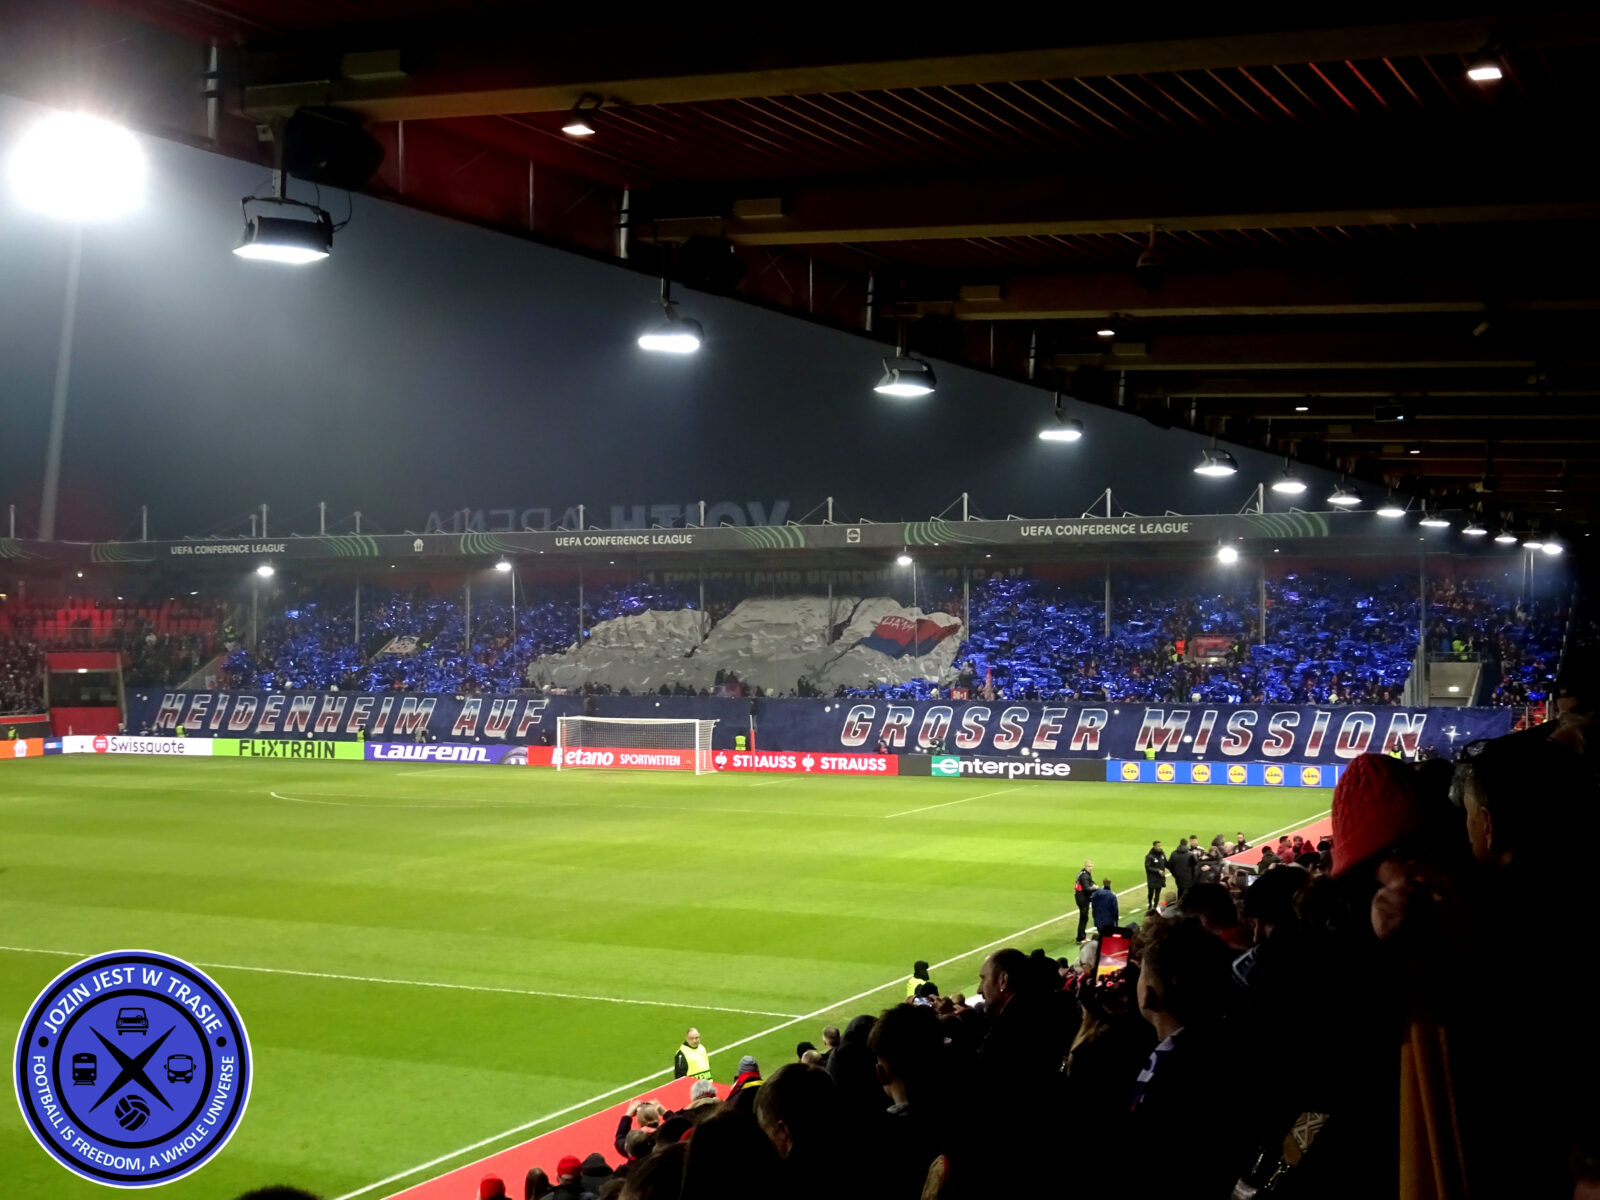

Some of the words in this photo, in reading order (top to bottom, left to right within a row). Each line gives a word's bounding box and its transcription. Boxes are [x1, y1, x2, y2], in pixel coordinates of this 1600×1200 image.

[1020, 525, 1053, 537] UEFA
[1055, 524, 1136, 536] CONFERENCE
[1139, 522, 1189, 534] LEAGUE
[555, 537, 582, 547] UEFA
[583, 535, 650, 546] CONFERENCE
[652, 534, 692, 545] LEAGUE
[170, 545, 194, 555] UEFA
[194, 544, 250, 555] CONFERENCE
[251, 543, 285, 553] LEAGUE
[155, 694, 437, 735] HEIDENHEIM
[451, 698, 549, 738] AUF
[841, 704, 1108, 751] GROSSER
[1134, 708, 1427, 759] MISSION
[110, 736, 185, 754] Swissquote
[619, 753, 681, 766] SPORTWETTEN
[732, 754, 797, 770] STRAUSS
[820, 756, 887, 772] STRAUSS
[932, 756, 1071, 779] enterprise
